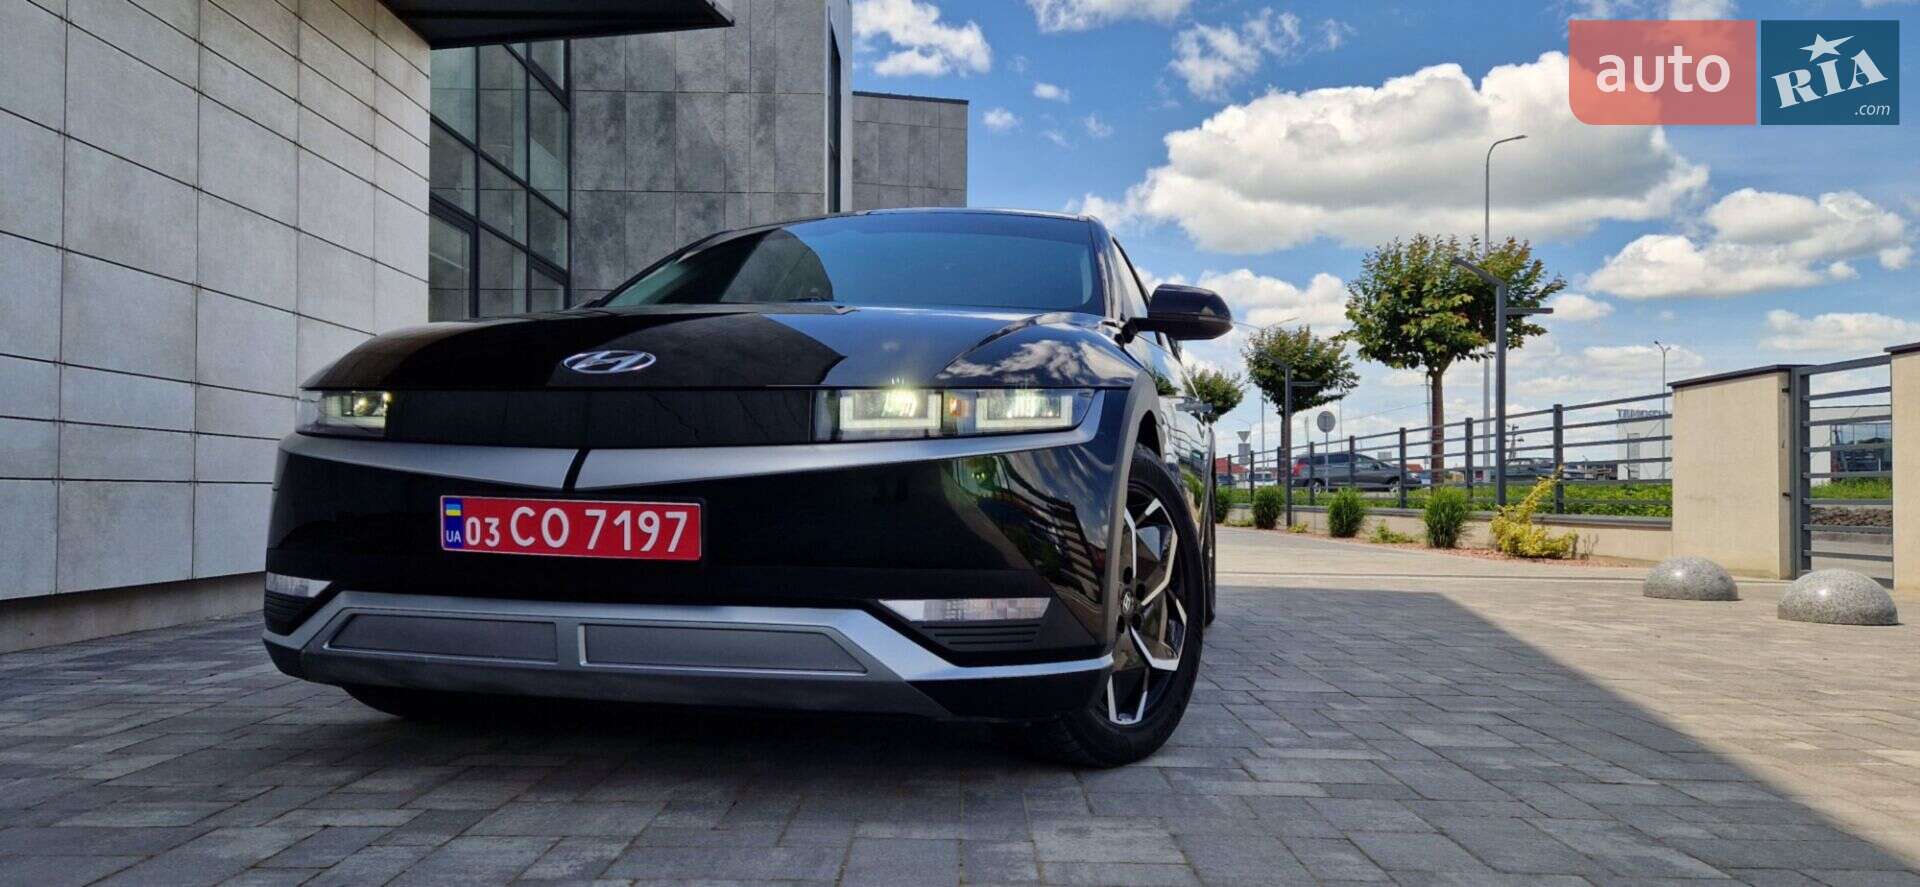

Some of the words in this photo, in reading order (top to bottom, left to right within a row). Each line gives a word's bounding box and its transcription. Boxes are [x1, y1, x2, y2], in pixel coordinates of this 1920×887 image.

[446, 530, 461, 543] UA
[465, 516, 500, 547] 03
[510, 506, 570, 548] CO
[584, 509, 688, 553] 7197
